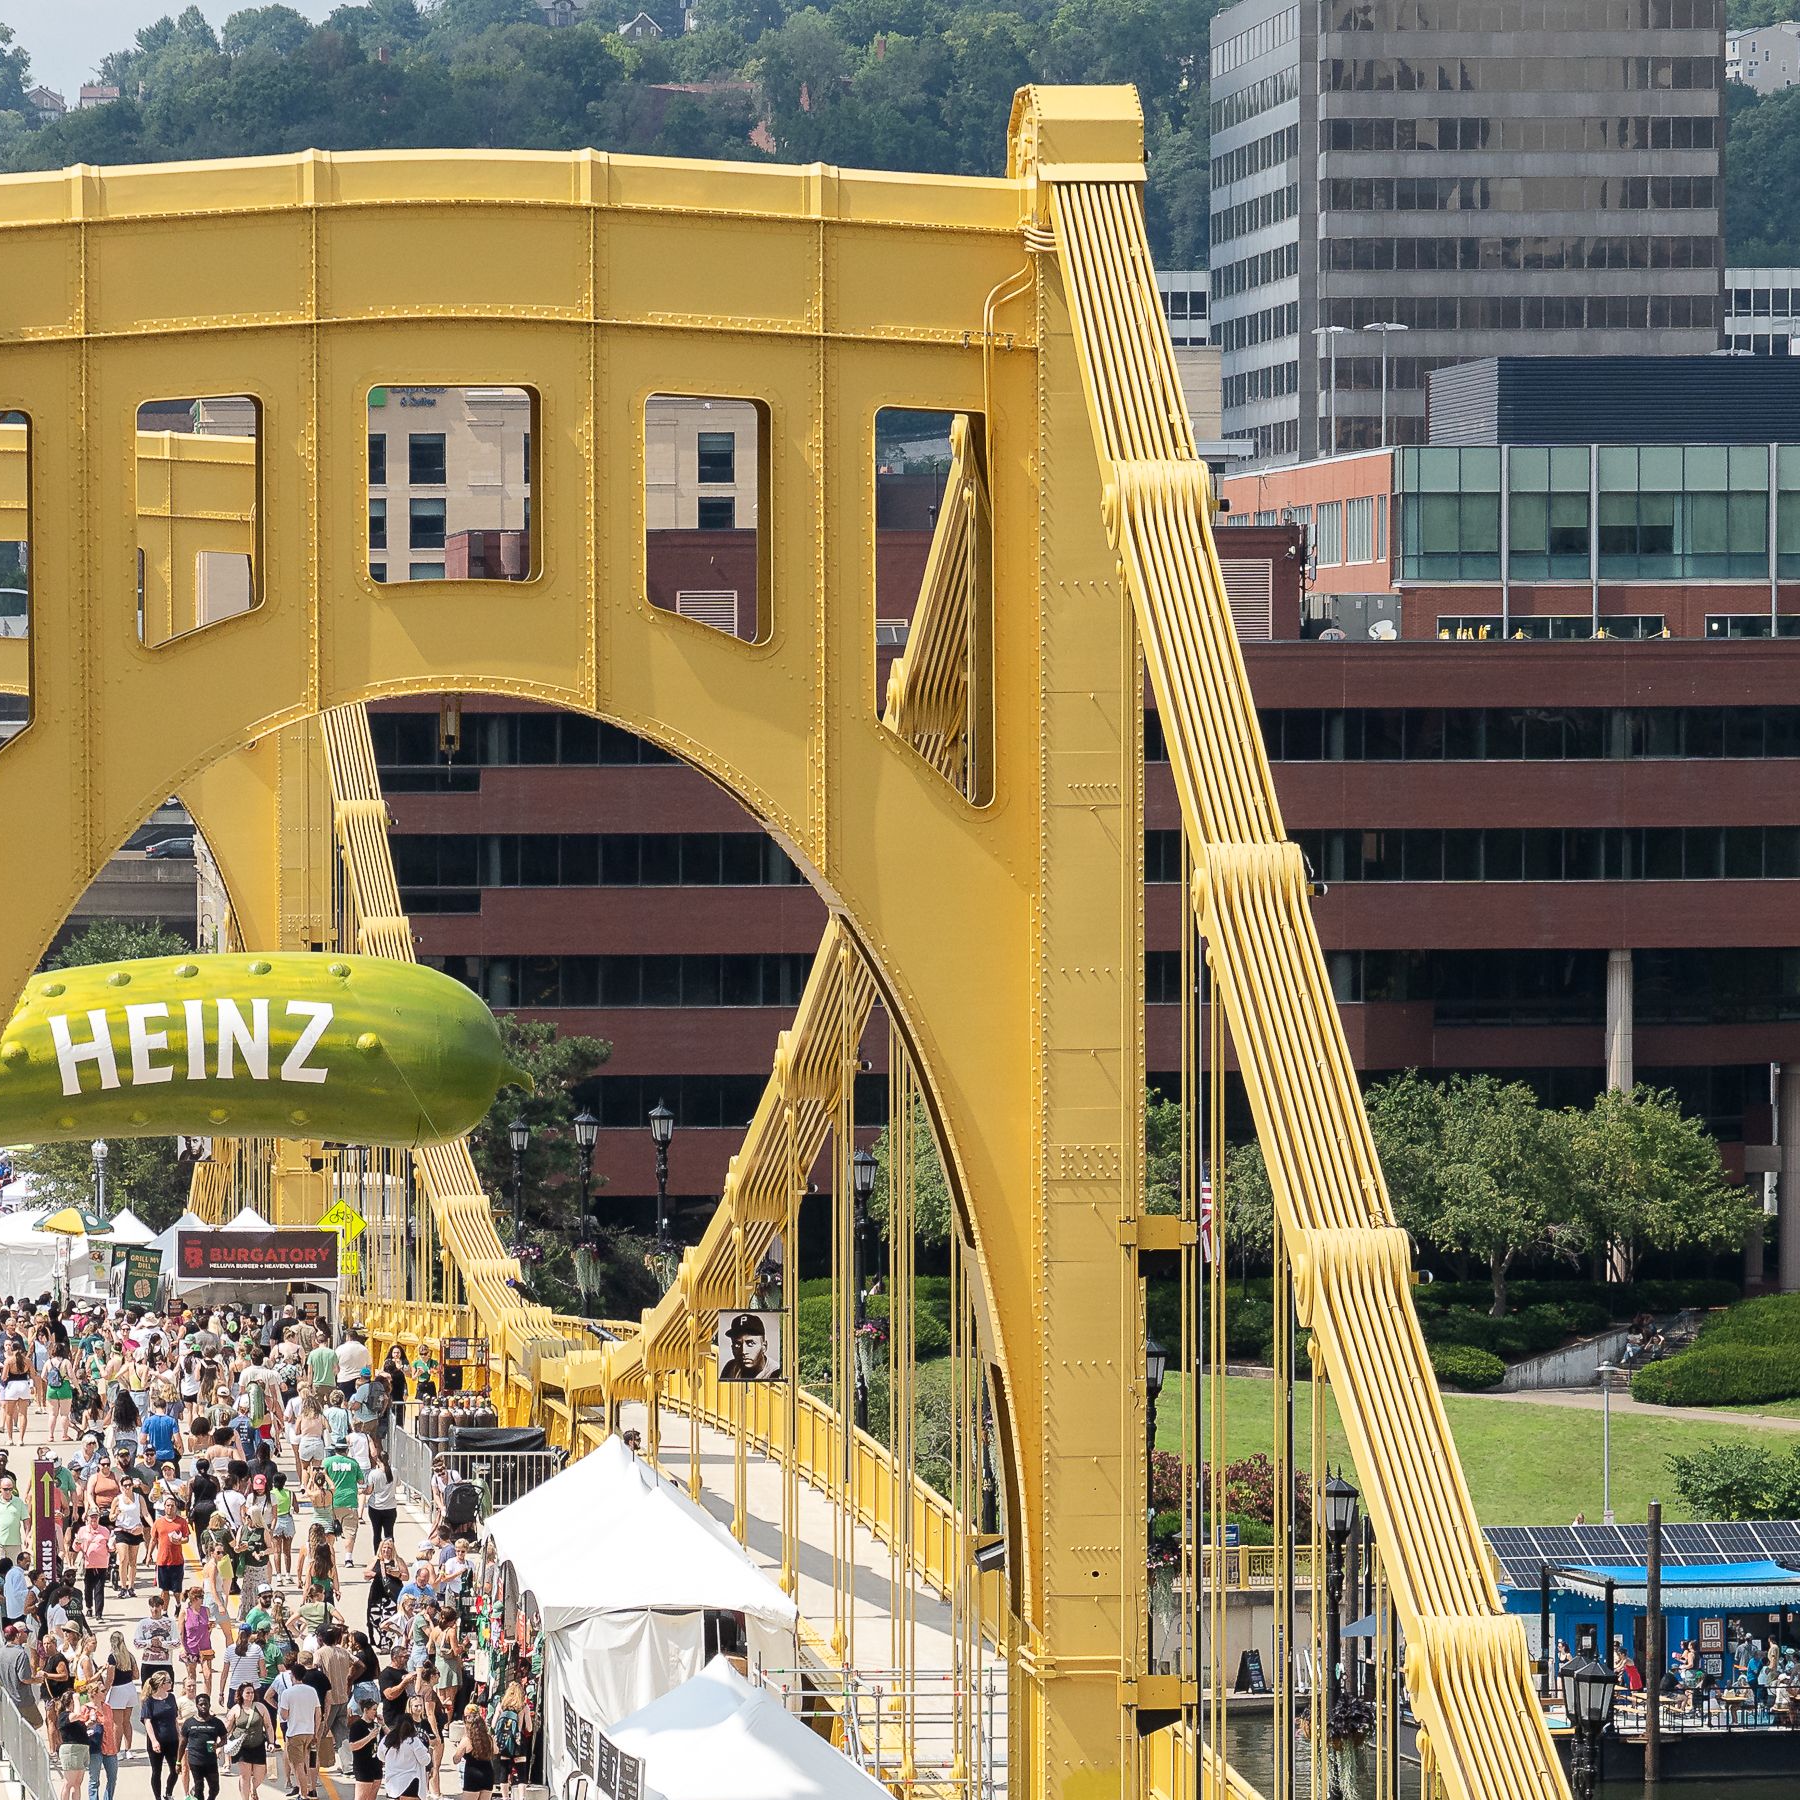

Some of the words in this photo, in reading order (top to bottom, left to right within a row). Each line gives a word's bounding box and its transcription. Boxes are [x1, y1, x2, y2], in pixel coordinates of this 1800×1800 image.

[46, 997, 335, 1097] HEINZ
[209, 1247, 330, 1263] BURGATORY
[740, 1316, 748, 1326] P
[1701, 1641, 1721, 1649] BEER
